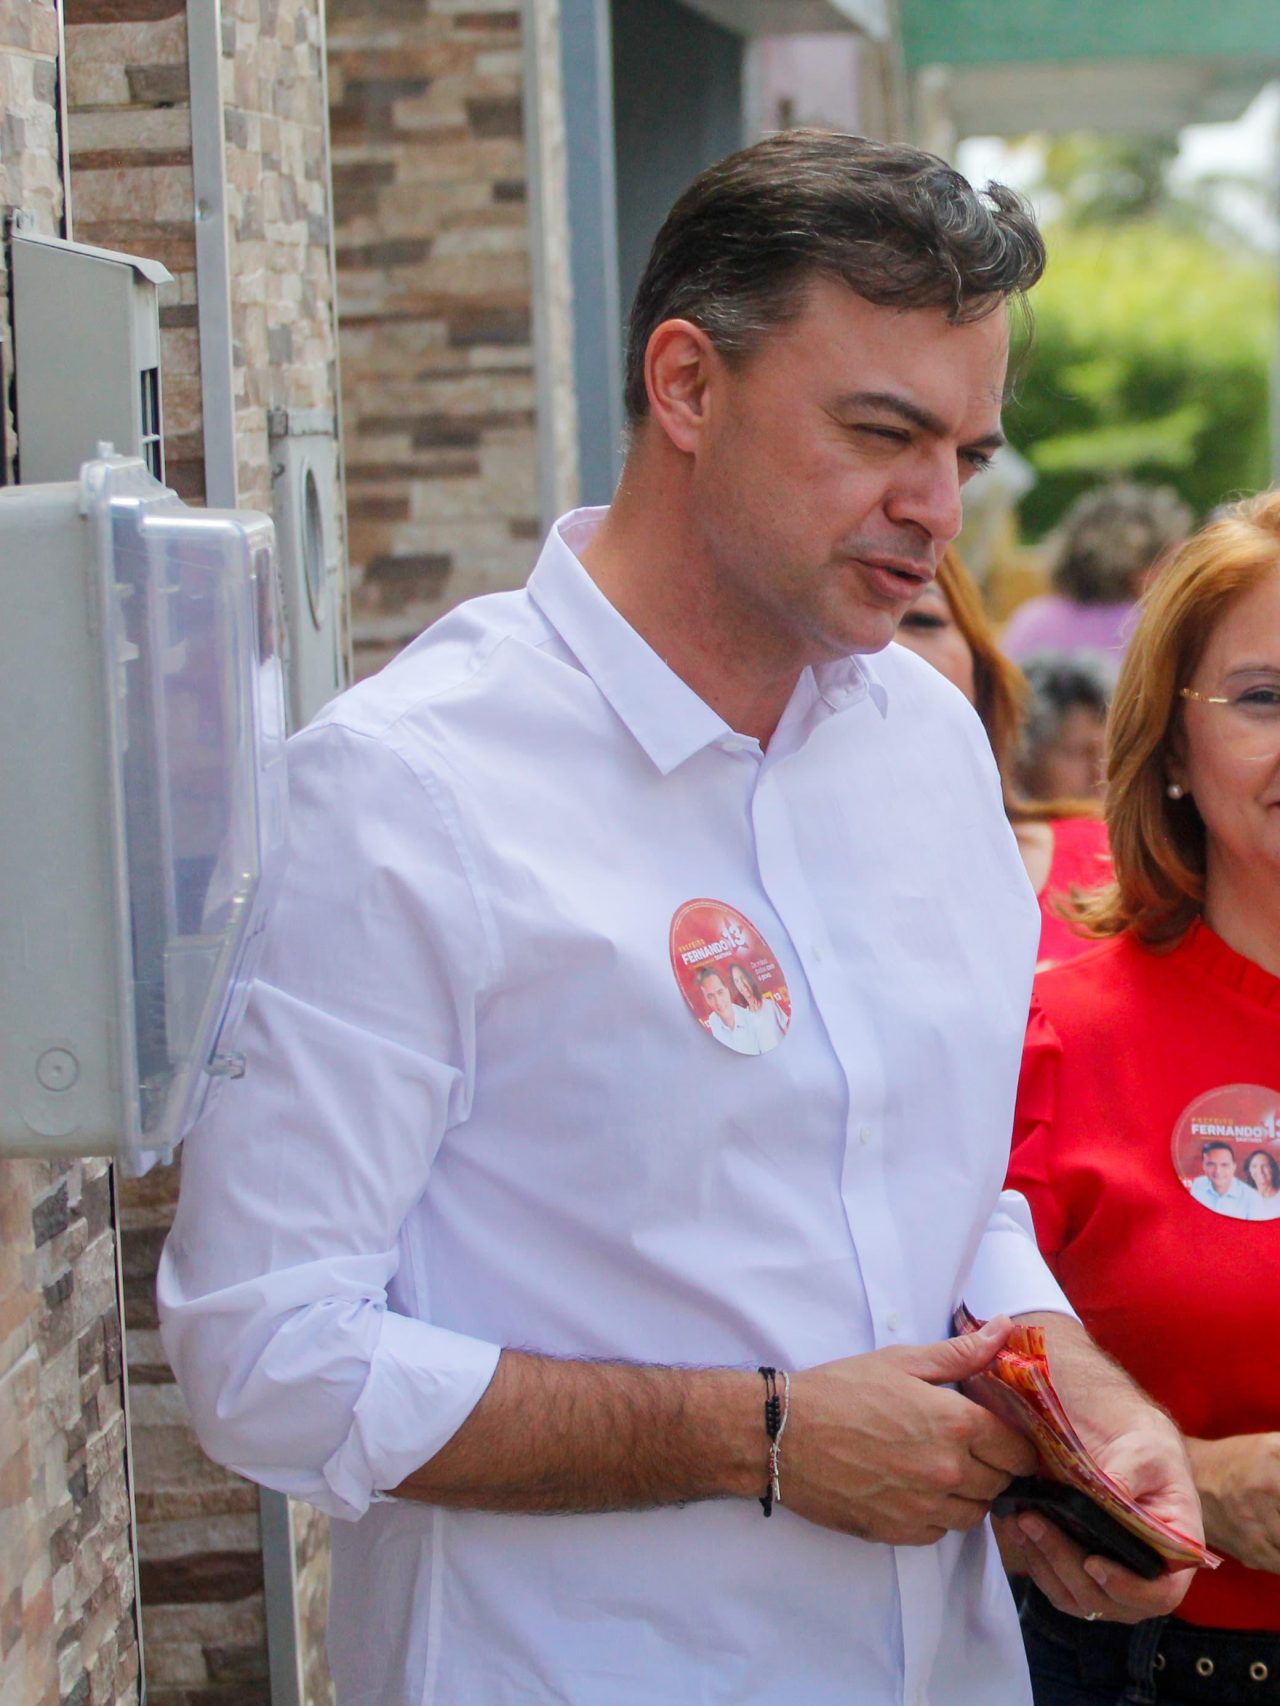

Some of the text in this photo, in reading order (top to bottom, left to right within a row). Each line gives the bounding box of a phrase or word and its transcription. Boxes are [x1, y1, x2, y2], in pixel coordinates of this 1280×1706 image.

[681, 940, 729, 966] FERNANDO
[720, 921, 746, 948] 13
[1191, 1123, 1263, 1138] FERNANDO
